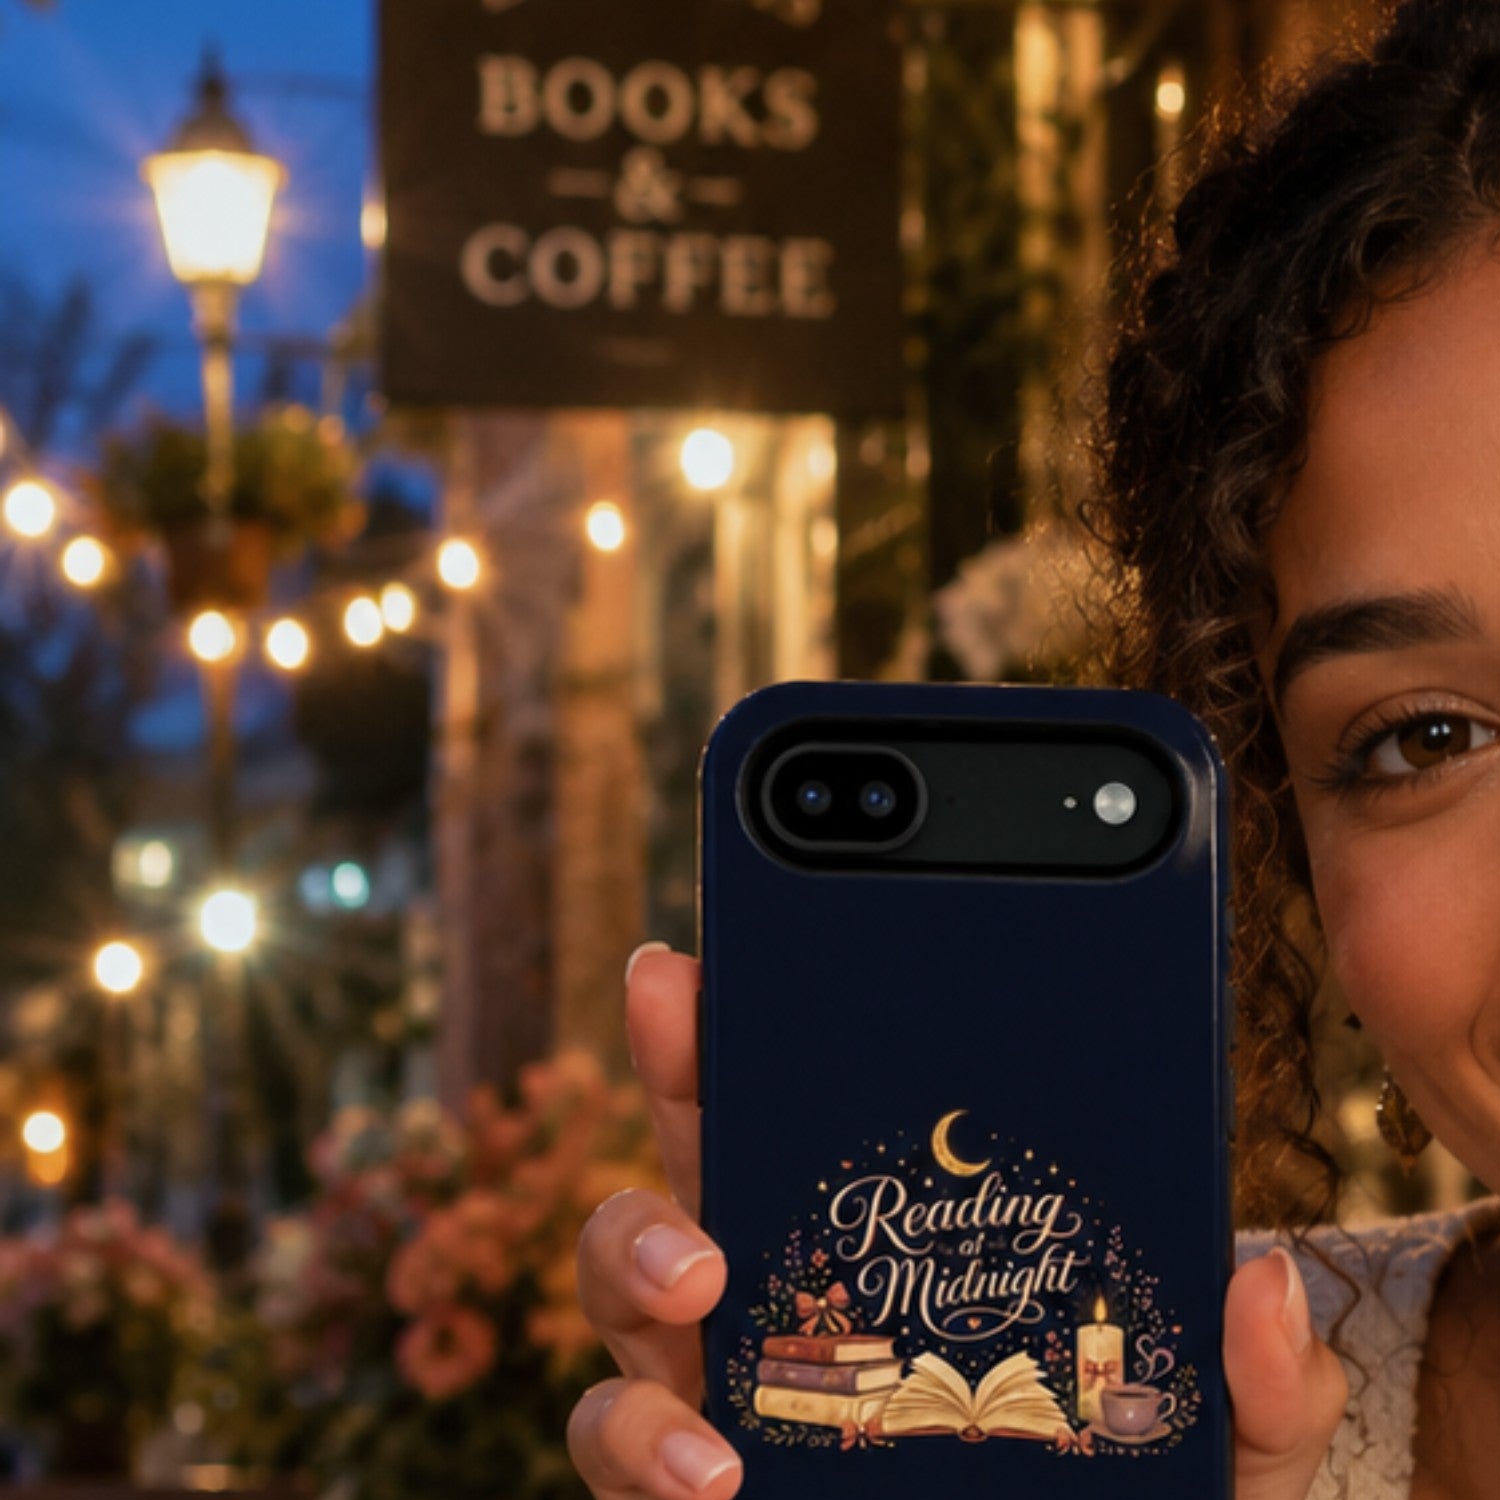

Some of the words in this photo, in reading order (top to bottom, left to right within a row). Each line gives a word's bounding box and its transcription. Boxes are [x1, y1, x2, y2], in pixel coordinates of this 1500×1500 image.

[477, 54, 820, 151] BOOKS
[614, 145, 686, 224] &
[459, 221, 837, 320] COFFEE
[829, 1171, 1082, 1261] Reading
[857, 1243, 1091, 1341] Midnight
